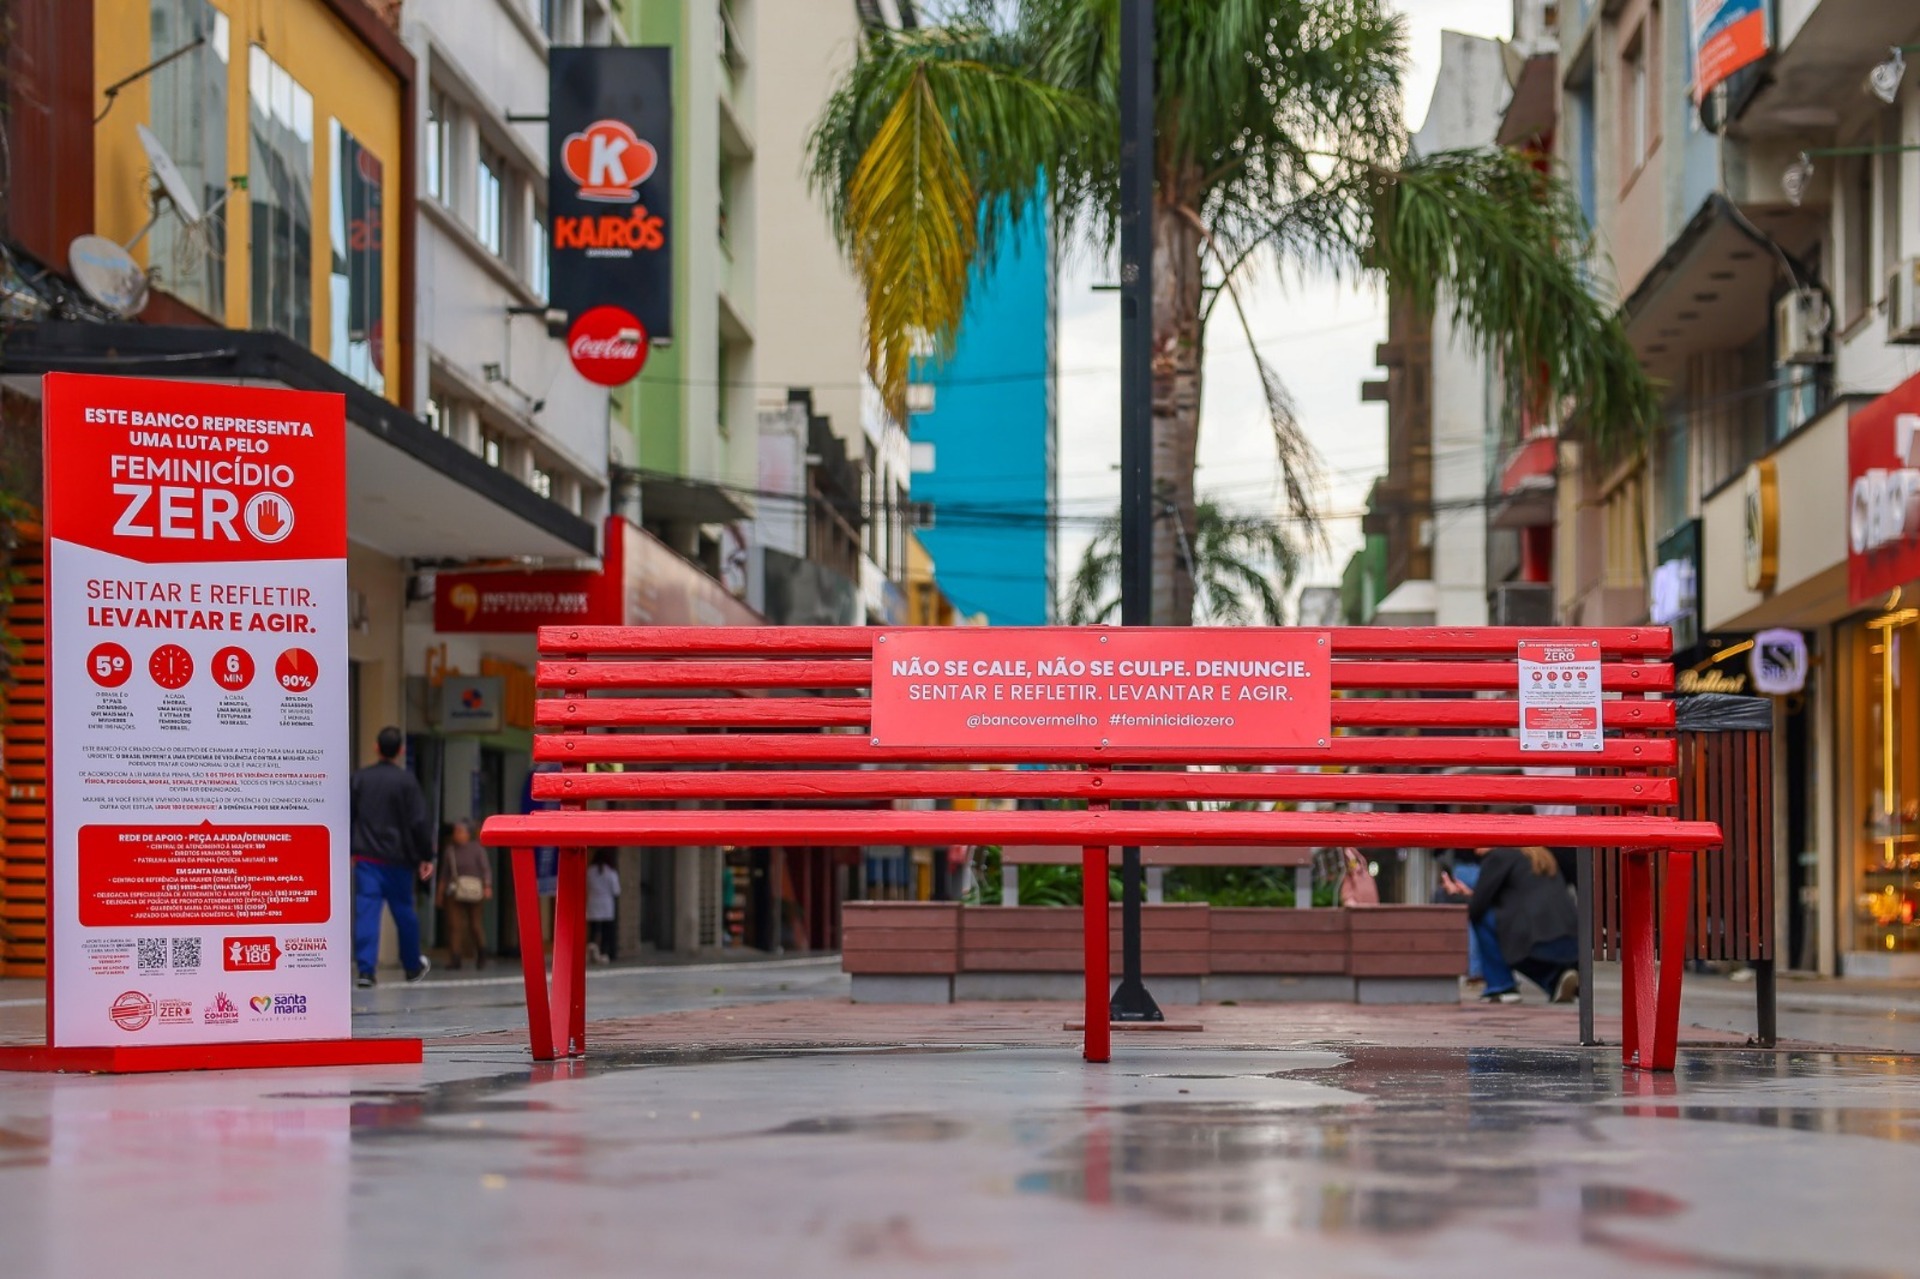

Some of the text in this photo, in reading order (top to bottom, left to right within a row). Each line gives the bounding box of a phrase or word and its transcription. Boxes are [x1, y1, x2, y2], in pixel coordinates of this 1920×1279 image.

[554, 205, 664, 249] KAIRÓS
[85, 408, 314, 437] ESTE BANCO REPRESENTA
[129, 431, 269, 454] UMA LUTA PELO
[111, 454, 294, 488] FEMINICÍDIO
[86, 579, 317, 607] SENTAR E REFLETIR.
[88, 606, 317, 633] LEVANTAR E AGIR.
[226, 654, 240, 673] 6
[1544, 652, 1575, 661] ZERO
[96, 655, 124, 677] 5º
[892, 656, 1311, 679] NÃO SE CALE, NÃO SE CULPE. DENUNCIE.
[223, 673, 243, 683] MIN
[282, 674, 312, 687] 90%
[909, 684, 1294, 701] SENTAR E REFLETIR. LEVANTAR E AGIR.
[966, 713, 1234, 728] @bancovermelho #feminicidiozero
[119, 832, 292, 843] REDE DE APOIO PEÇA AJUDA/DENUNCIE:
[285, 943, 327, 951] SOZINHA
[246, 951, 270, 963] 180
[274, 994, 306, 1005] santa
[274, 1004, 306, 1015] maria
